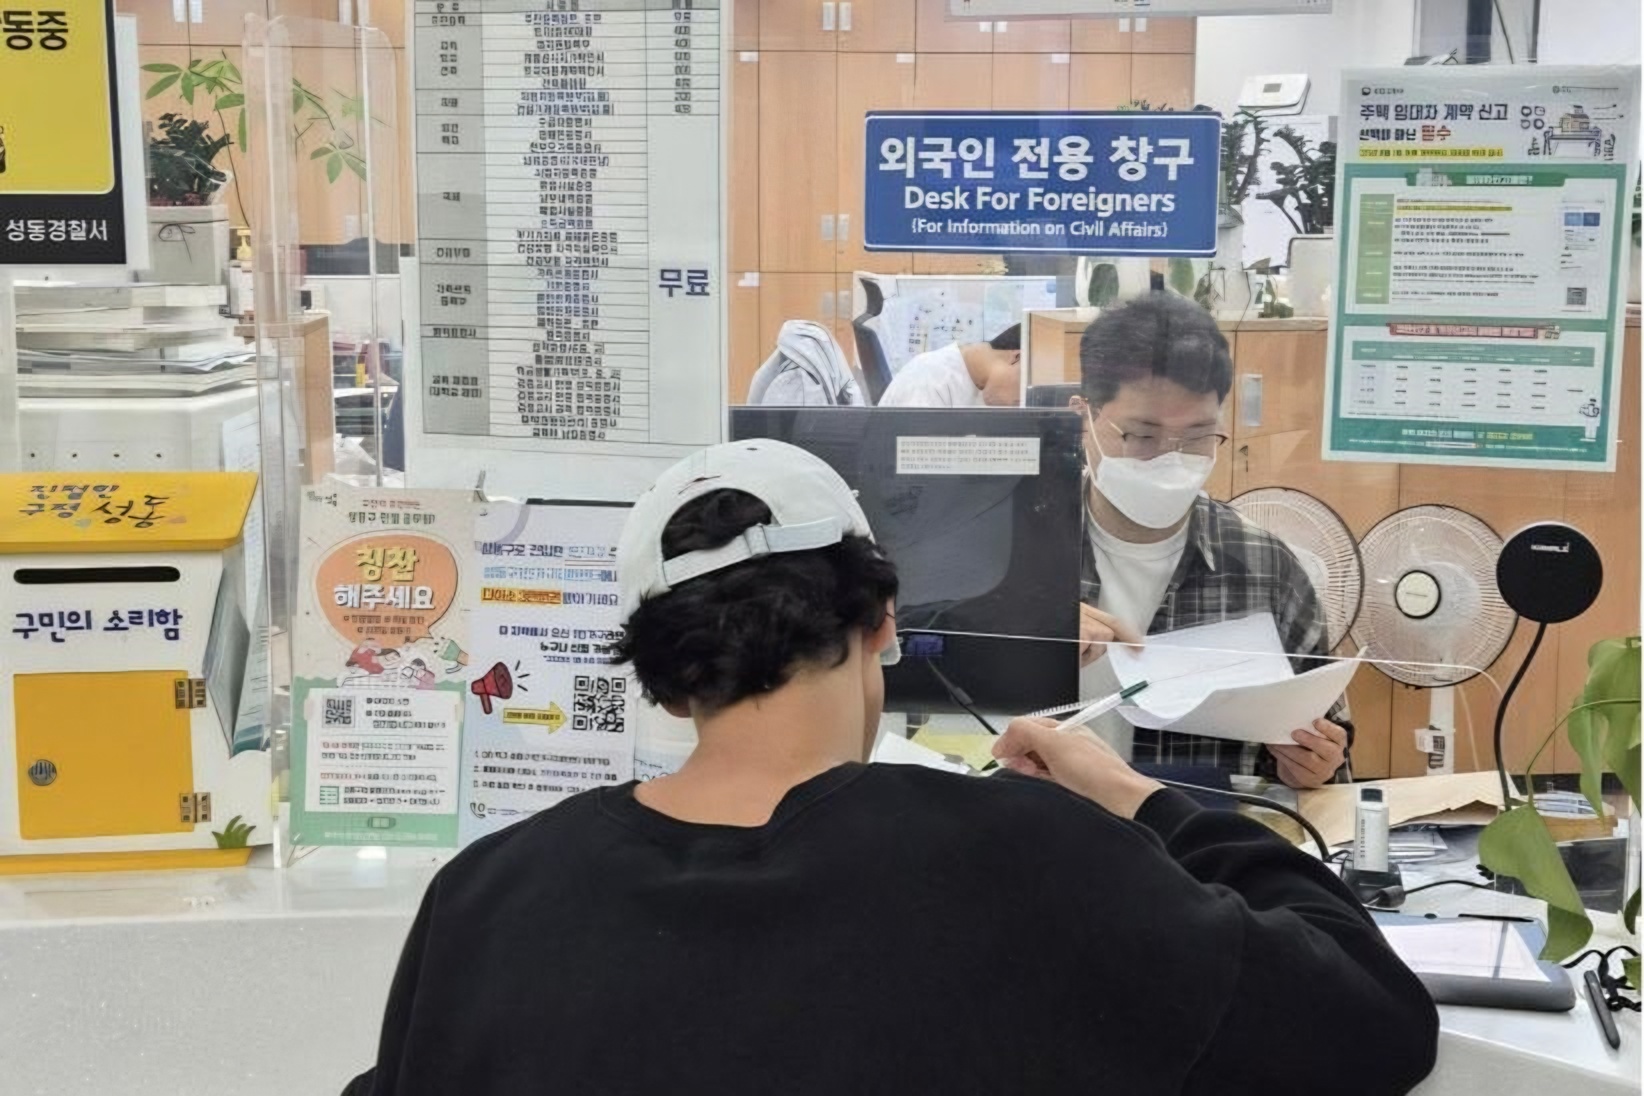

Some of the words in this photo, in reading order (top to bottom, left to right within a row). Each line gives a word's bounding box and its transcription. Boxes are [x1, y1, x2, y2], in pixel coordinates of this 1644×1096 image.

[0, 10, 69, 51] 동중
[1360, 103, 1390, 121] 주택
[1395, 103, 1438, 121] 임대차
[1444, 103, 1474, 121] 계약
[1479, 103, 1509, 121] 신고
[878, 136, 995, 180] 외국인
[1011, 136, 1095, 182] 전용
[1109, 135, 1195, 182] 창구
[904, 186, 970, 210] Desk
[976, 186, 1020, 210] For
[1028, 186, 1175, 218] Foreigners
[5, 219, 109, 242] 성동경찰서
[911, 217, 943, 234] (For
[948, 218, 1041, 236] Information
[1045, 222, 1065, 236] on
[1070, 220, 1104, 237] Civil
[1108, 222, 1168, 238] Affairs)
[658, 268, 711, 298] 무료
[357, 544, 420, 583] 칭찬
[333, 584, 436, 611] 해주세요
[12, 610, 93, 643] 구민의
[103, 609, 184, 641] 소리함
